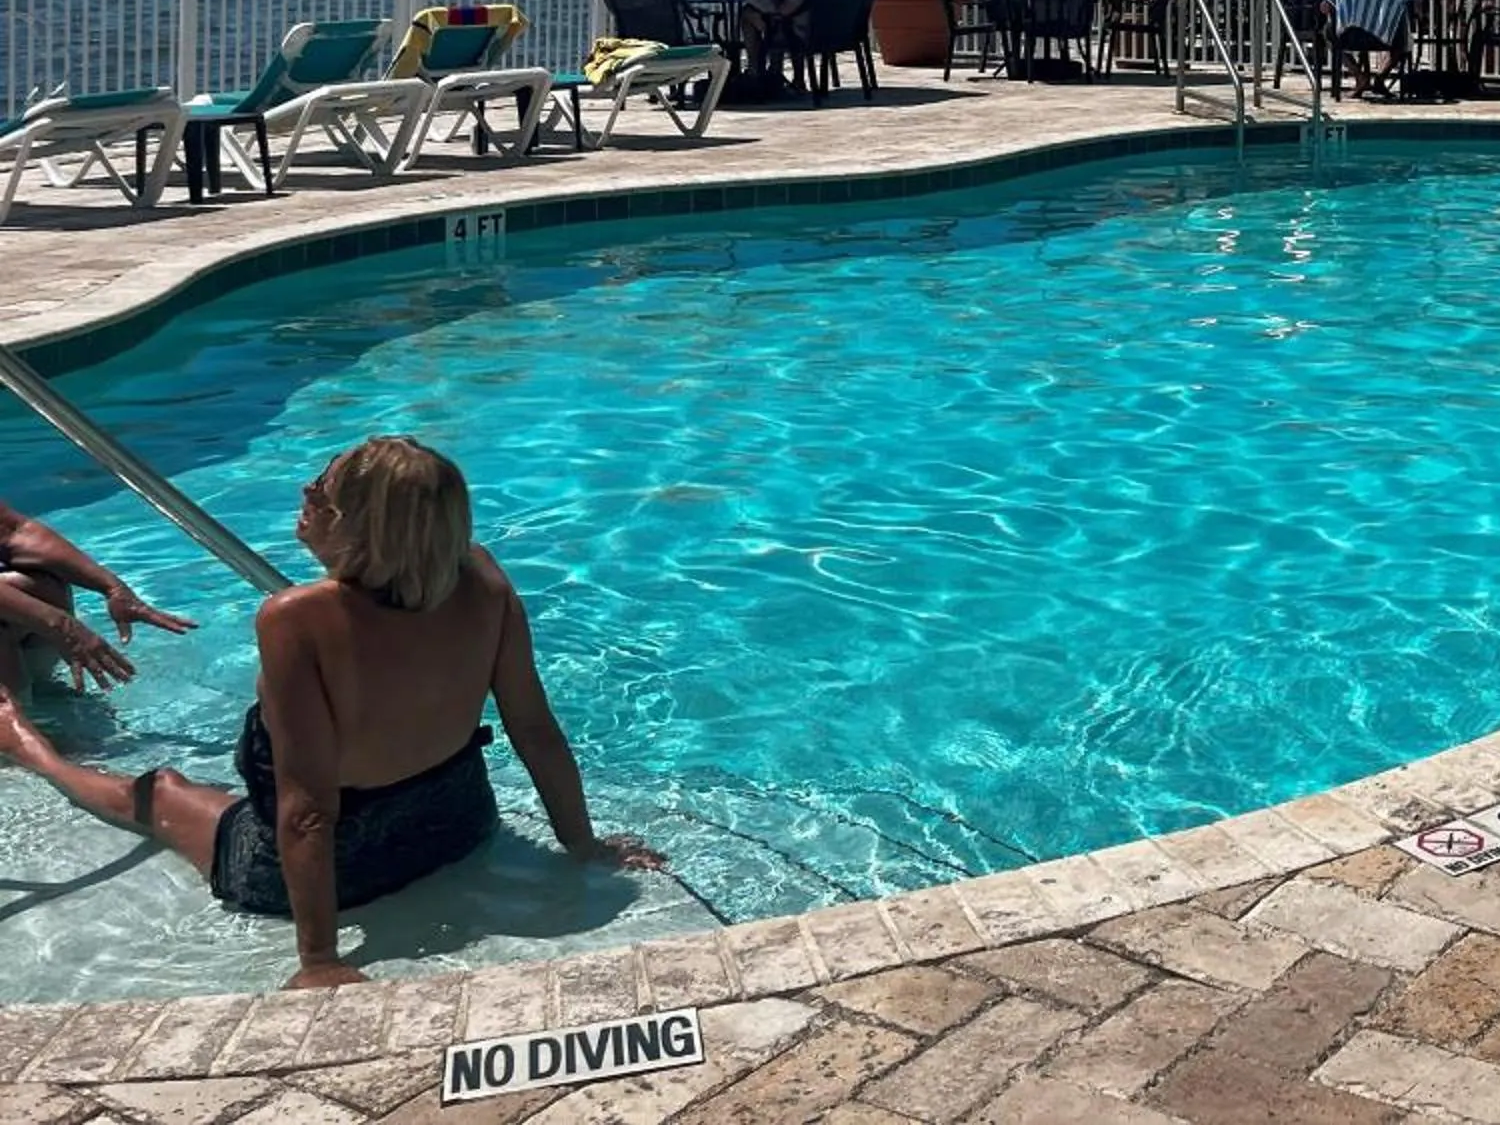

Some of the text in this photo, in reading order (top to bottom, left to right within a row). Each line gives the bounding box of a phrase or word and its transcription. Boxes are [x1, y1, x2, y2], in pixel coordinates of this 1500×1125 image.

[1326, 127, 1344, 140] FT
[453, 214, 502, 240] 4 FT
[1444, 860, 1469, 873] NO
[450, 1015, 697, 1094] NO DIVING
